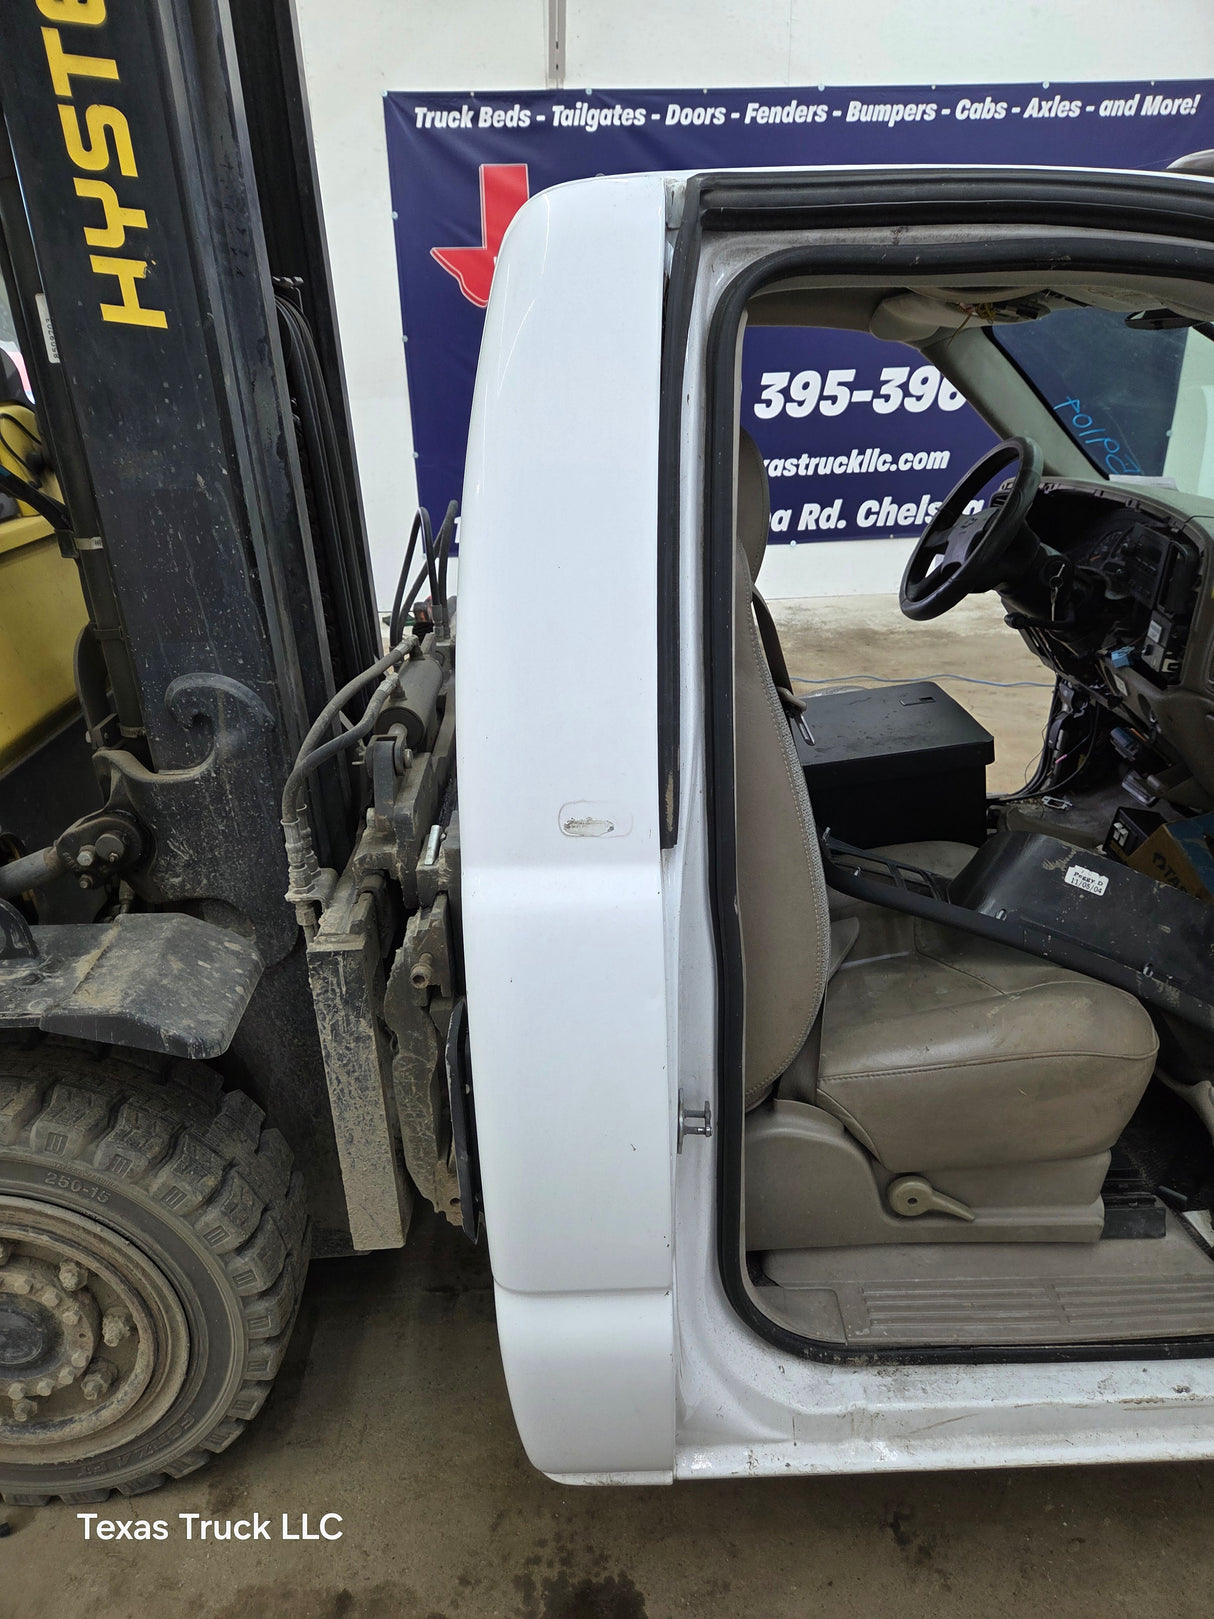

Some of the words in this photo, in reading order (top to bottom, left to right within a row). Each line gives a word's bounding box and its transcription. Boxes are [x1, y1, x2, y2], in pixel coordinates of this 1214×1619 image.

[415, 105, 475, 128] Truck
[478, 104, 532, 128] Beds
[552, 101, 647, 132] Tailgates
[665, 103, 727, 126] Doors
[744, 100, 828, 124] Fenders
[845, 100, 938, 127] Bumpers
[955, 96, 1007, 120] Cabs
[1023, 95, 1082, 118] Axles
[1099, 94, 1141, 117] and
[1140, 94, 1201, 116] More!
[769, 509, 792, 532] a
[797, 498, 847, 531] Rd.
[856, 494, 985, 528] Chelsa
[45, 1171, 112, 1204] 250-15
